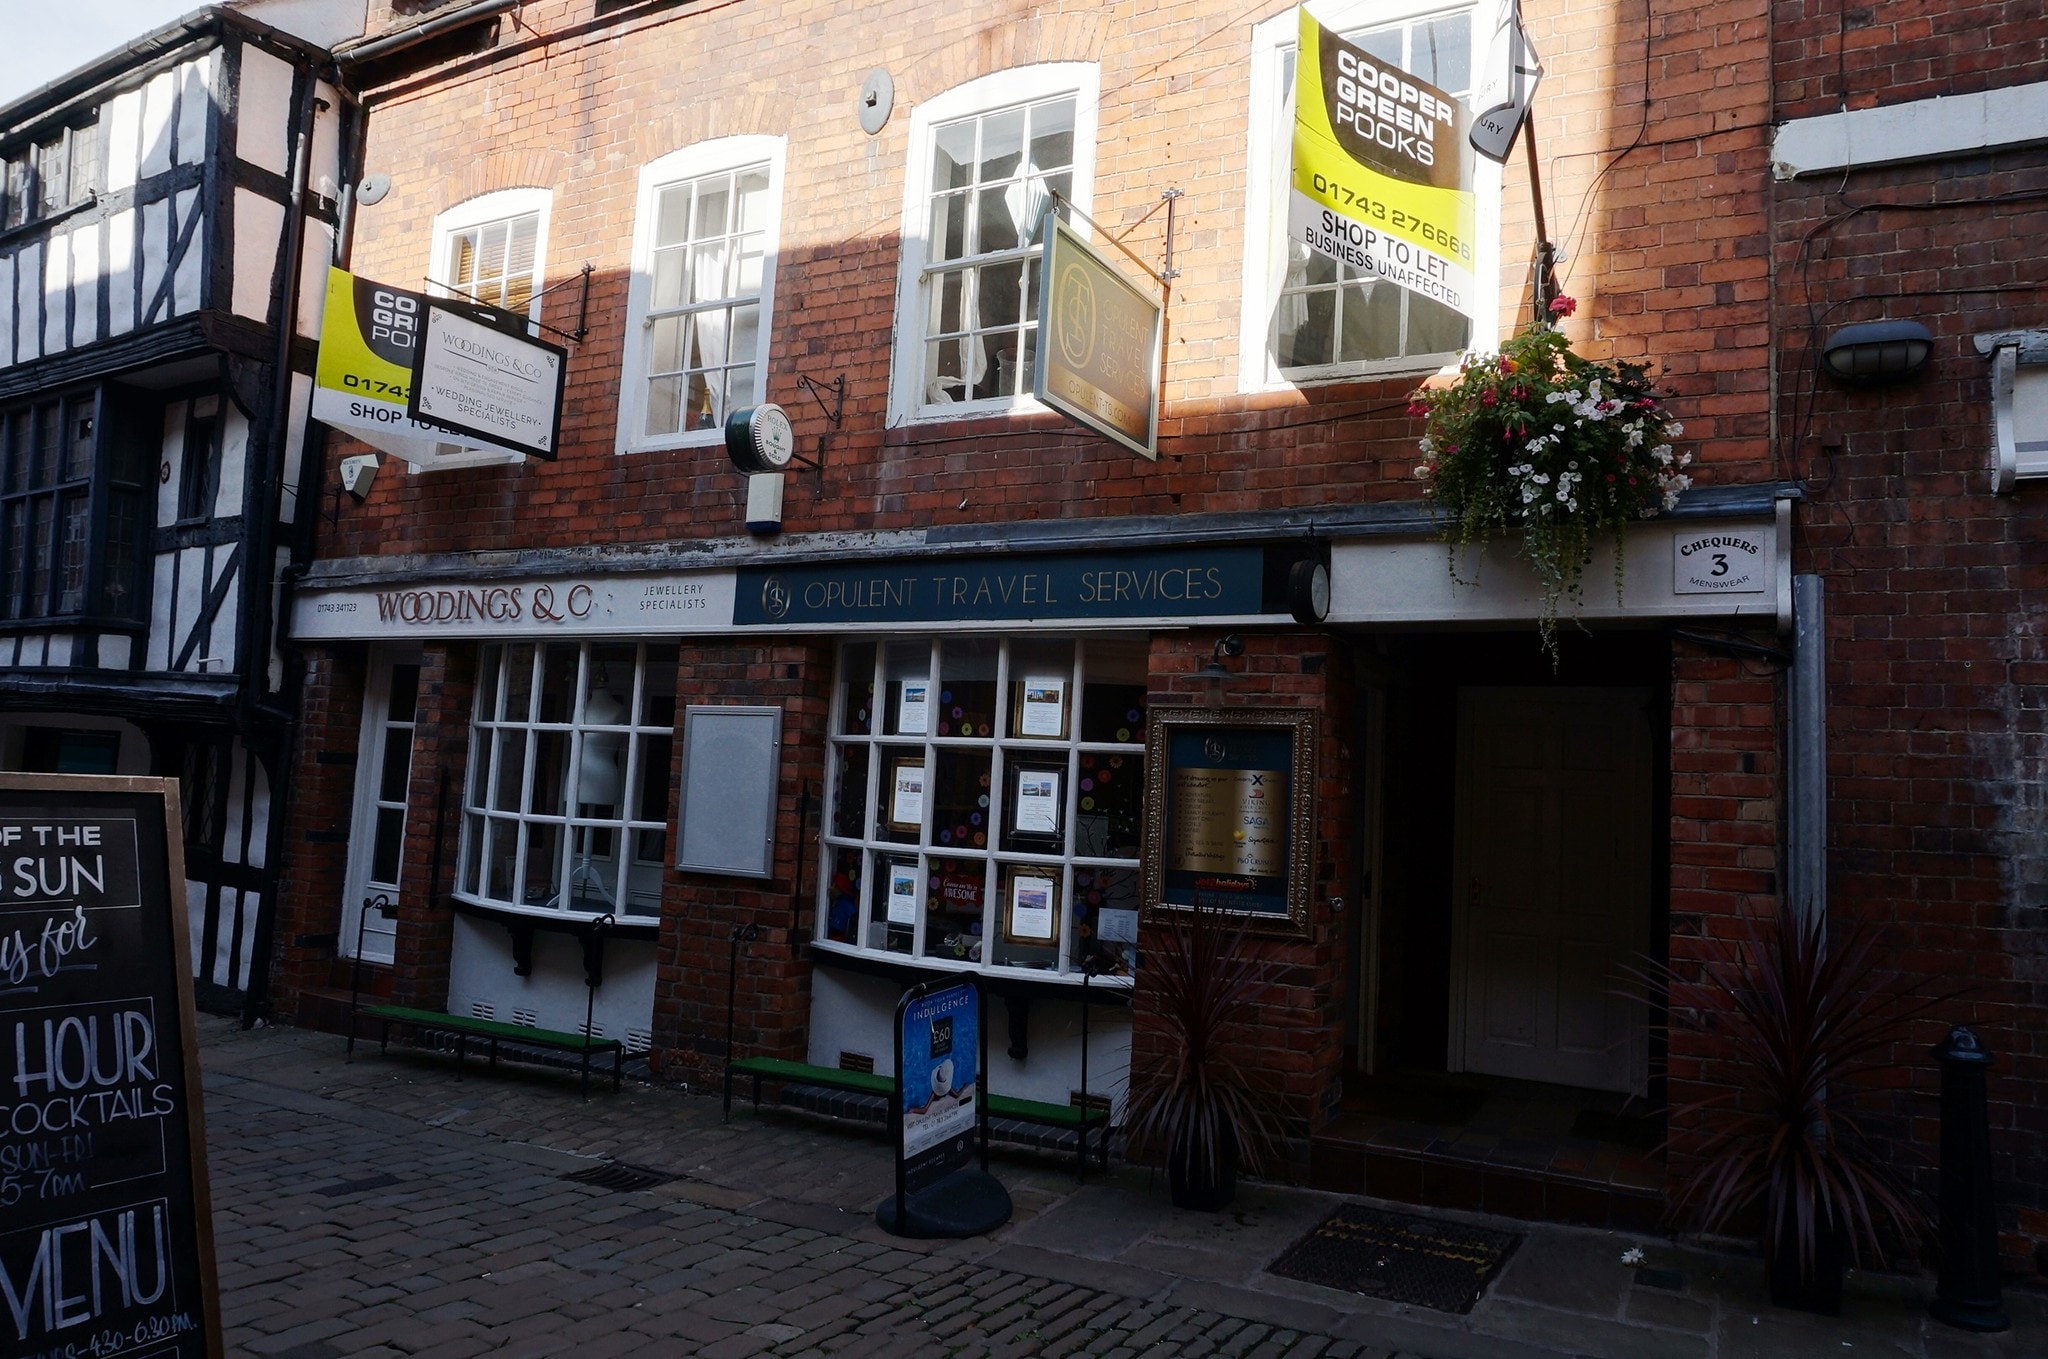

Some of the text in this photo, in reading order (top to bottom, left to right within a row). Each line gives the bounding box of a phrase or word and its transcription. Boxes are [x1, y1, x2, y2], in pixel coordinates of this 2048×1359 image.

[1337, 49, 1453, 127] COOPER
[1337, 76, 1434, 142] GREEN
[1336, 102, 1434, 166] POOKS
[1313, 173, 1471, 261] 01743 276666
[1322, 210, 1449, 282] SHOP TO LET
[1306, 226, 1461, 308] BUSINESS UNAFFECTED
[1103, 299, 1149, 345] OPULENT
[442, 331, 510, 366] WOODINGS
[1102, 324, 1147, 373] TRAVEL
[1100, 352, 1145, 399] SERVICES
[350, 402, 402, 423] SHOP
[435, 386, 482, 409] WEDDING
[485, 403, 538, 426] JEWELLERY
[457, 404, 516, 429] SPECIALISTS
[1680, 536, 1758, 556] CHEQUERS
[1711, 553, 1729, 576] 3
[644, 584, 704, 596] JEWELLERY
[804, 578, 918, 609] OPULENT
[933, 573, 1058, 605] TRAVEL
[1079, 567, 1223, 602] SERVICES
[1689, 575, 1750, 588] MENSWEAR
[317, 603, 335, 613] 01743
[376, 587, 522, 622] WOODINGS
[532, 584, 565, 621] &
[640, 598, 706, 610] SPECIALISTS
[32, 825, 102, 847] THE
[1243, 816, 1269, 826] SAGA
[13, 855, 105, 897] SUN
[943, 887, 977, 901] AWESOME
[39, 905, 98, 978] for
[913, 995, 969, 1021] INDULGENCE
[13, 1010, 157, 1097] HOUR
[933, 1027, 951, 1045] £60
